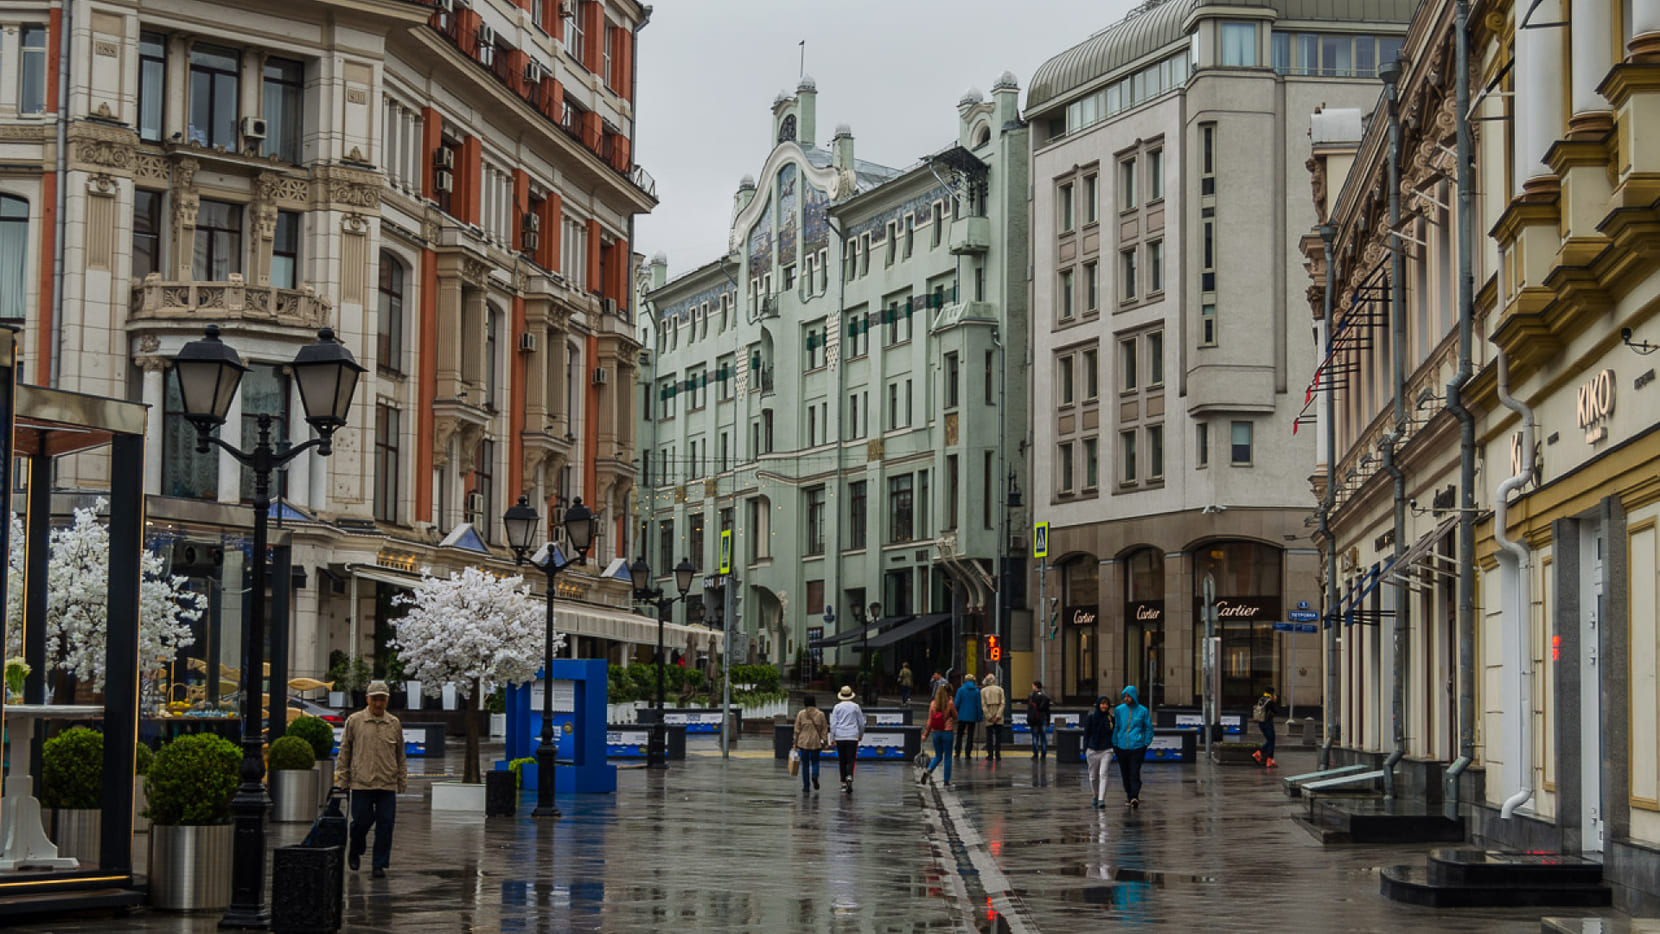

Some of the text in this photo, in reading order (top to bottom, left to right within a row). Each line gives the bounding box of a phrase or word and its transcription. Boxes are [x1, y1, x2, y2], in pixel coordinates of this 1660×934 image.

[1577, 369, 1612, 429] KIKO
[1073, 609, 1095, 624] Cartier
[1136, 604, 1160, 620] Cartier
[1216, 600, 1259, 617] Cartier
